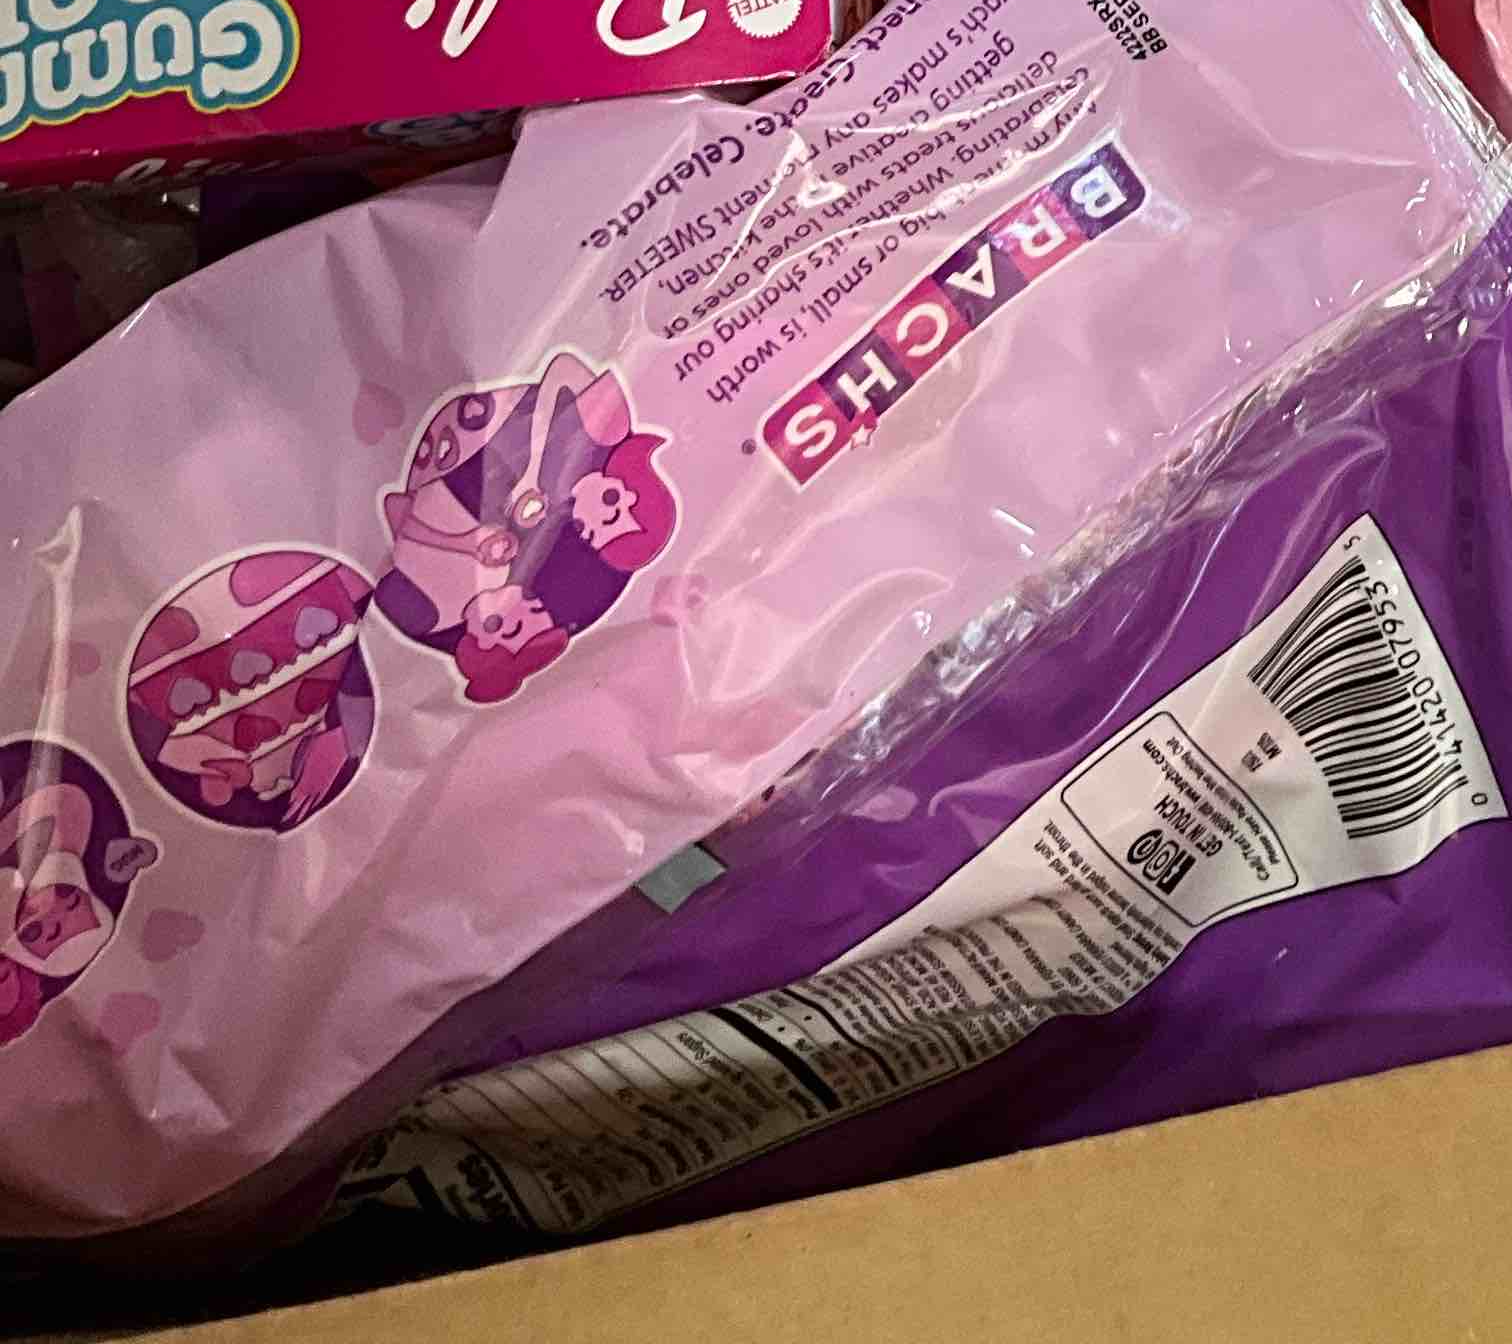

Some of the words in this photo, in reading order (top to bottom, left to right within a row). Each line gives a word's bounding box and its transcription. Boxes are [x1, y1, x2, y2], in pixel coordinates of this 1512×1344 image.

[1149, 25, 1170, 56] BB
[745, 57, 857, 137] Create.
[873, 40, 949, 115] makes
[930, 28, 1016, 113] getting
[824, 111, 872, 149] any
[880, 126, 957, 182] treats
[580, 135, 746, 249] Celebrate.
[821, 177, 881, 220] with
[597, 214, 717, 305] SWEETER.
[752, 217, 824, 270] loved
[807, 235, 846, 270] it's
[875, 234, 901, 265] or
[691, 267, 751, 319] ones
[712, 262, 808, 345] sharing
[783, 162, 1129, 460] BRACH'S
[799, 255, 874, 325] small,
[663, 315, 690, 340] or
[779, 317, 809, 344] is
[673, 339, 715, 383] our
[705, 338, 783, 405] worth
[1364, 579, 1422, 671] 07953
[1410, 675, 1464, 758] 41420
[1153, 793, 1193, 835] TOUCH
[1470, 791, 1490, 807] 0
